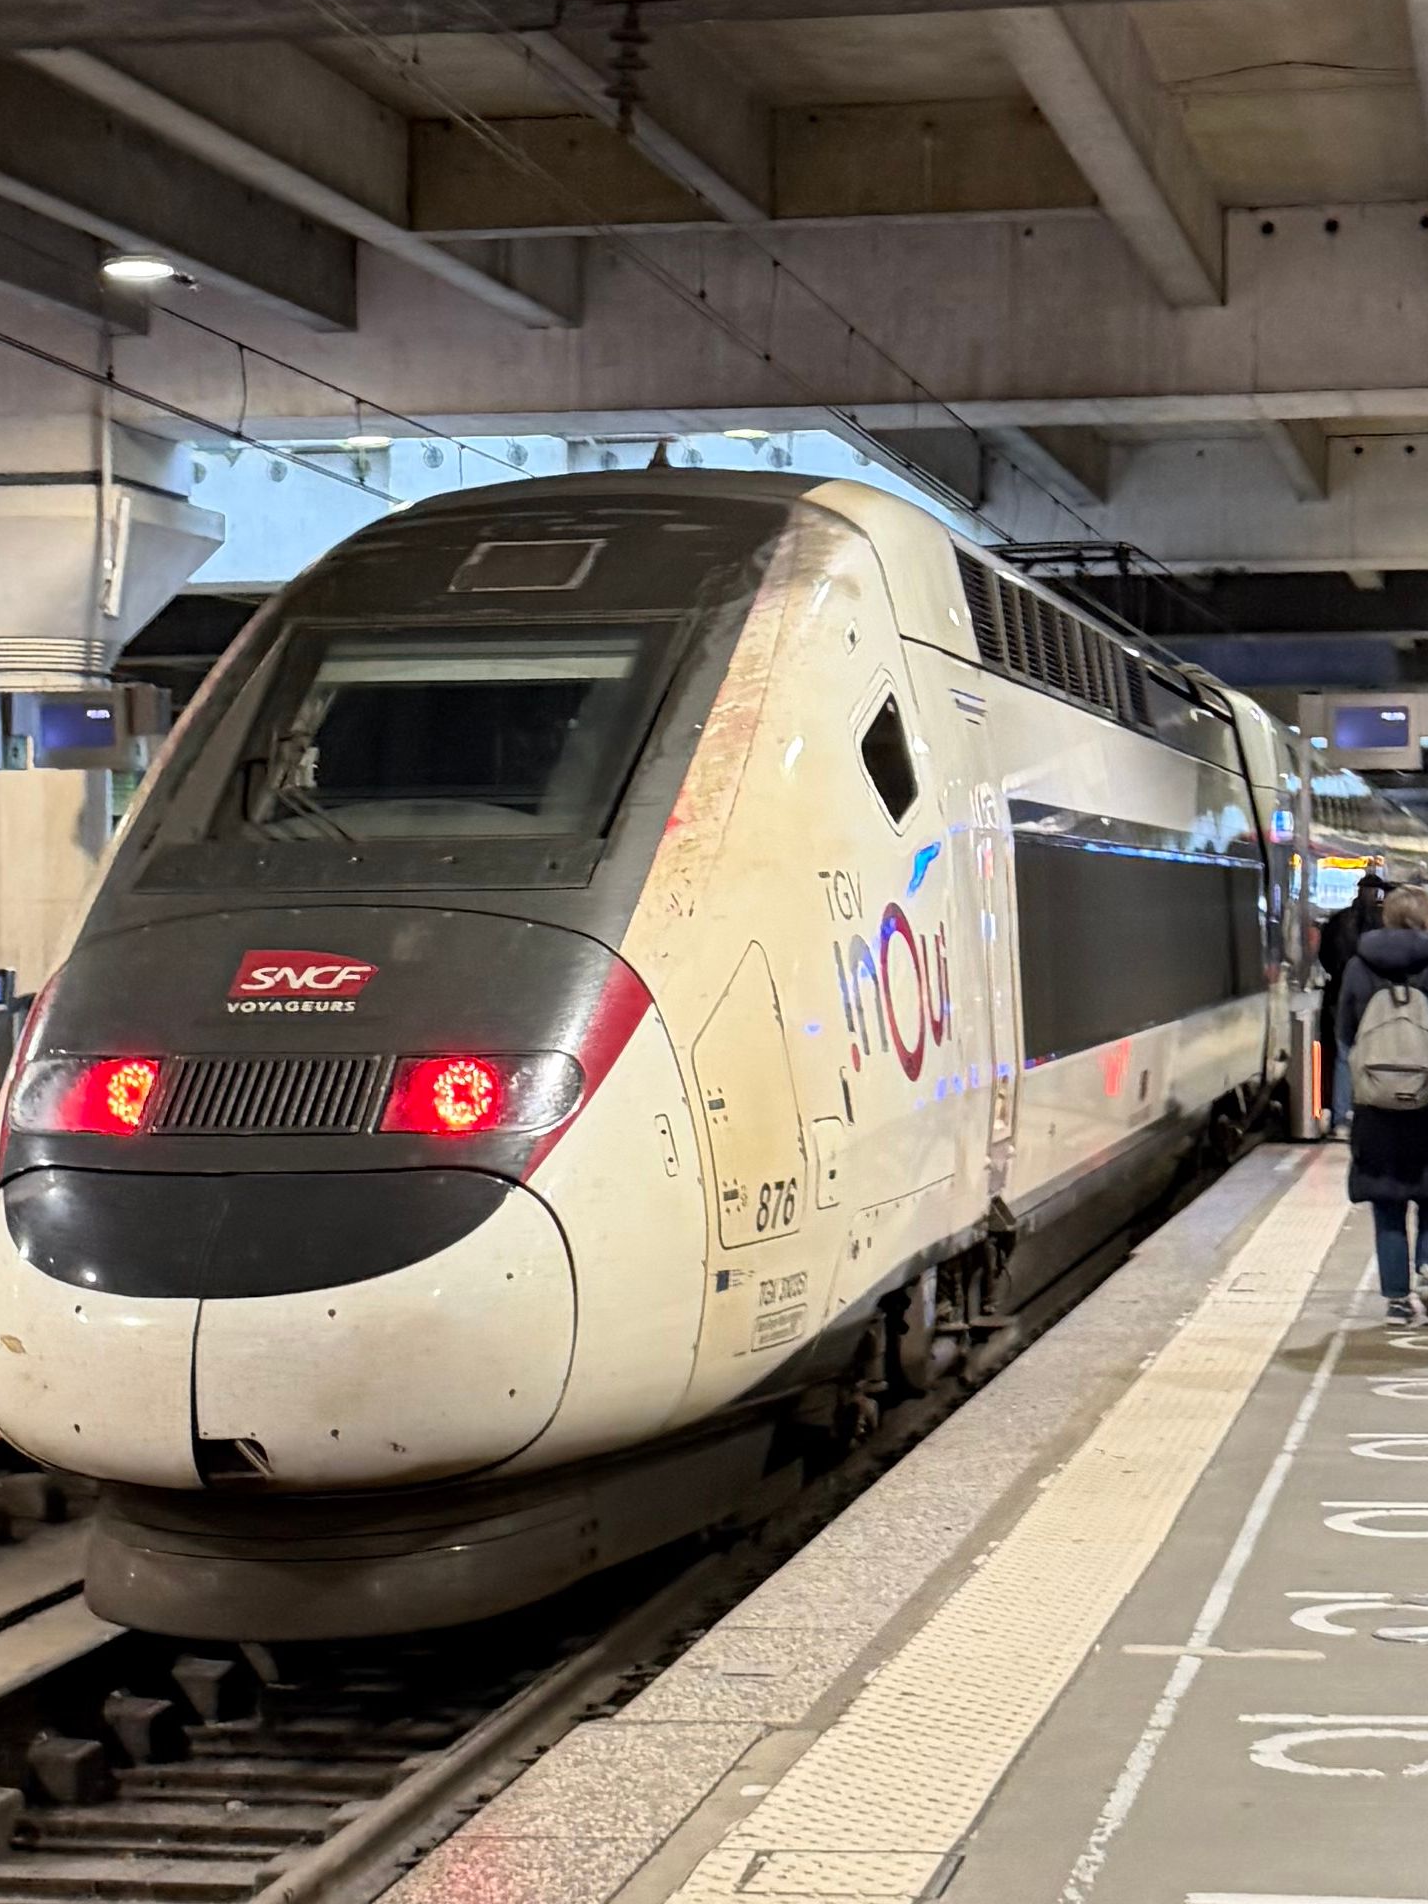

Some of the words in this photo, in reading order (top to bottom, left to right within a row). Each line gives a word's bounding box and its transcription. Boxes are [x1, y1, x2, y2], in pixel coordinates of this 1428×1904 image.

[817, 869, 864, 922] TGV
[240, 965, 372, 991] SNCF
[226, 1000, 357, 1014] VOYAGEURS
[755, 1176, 799, 1233] 876
